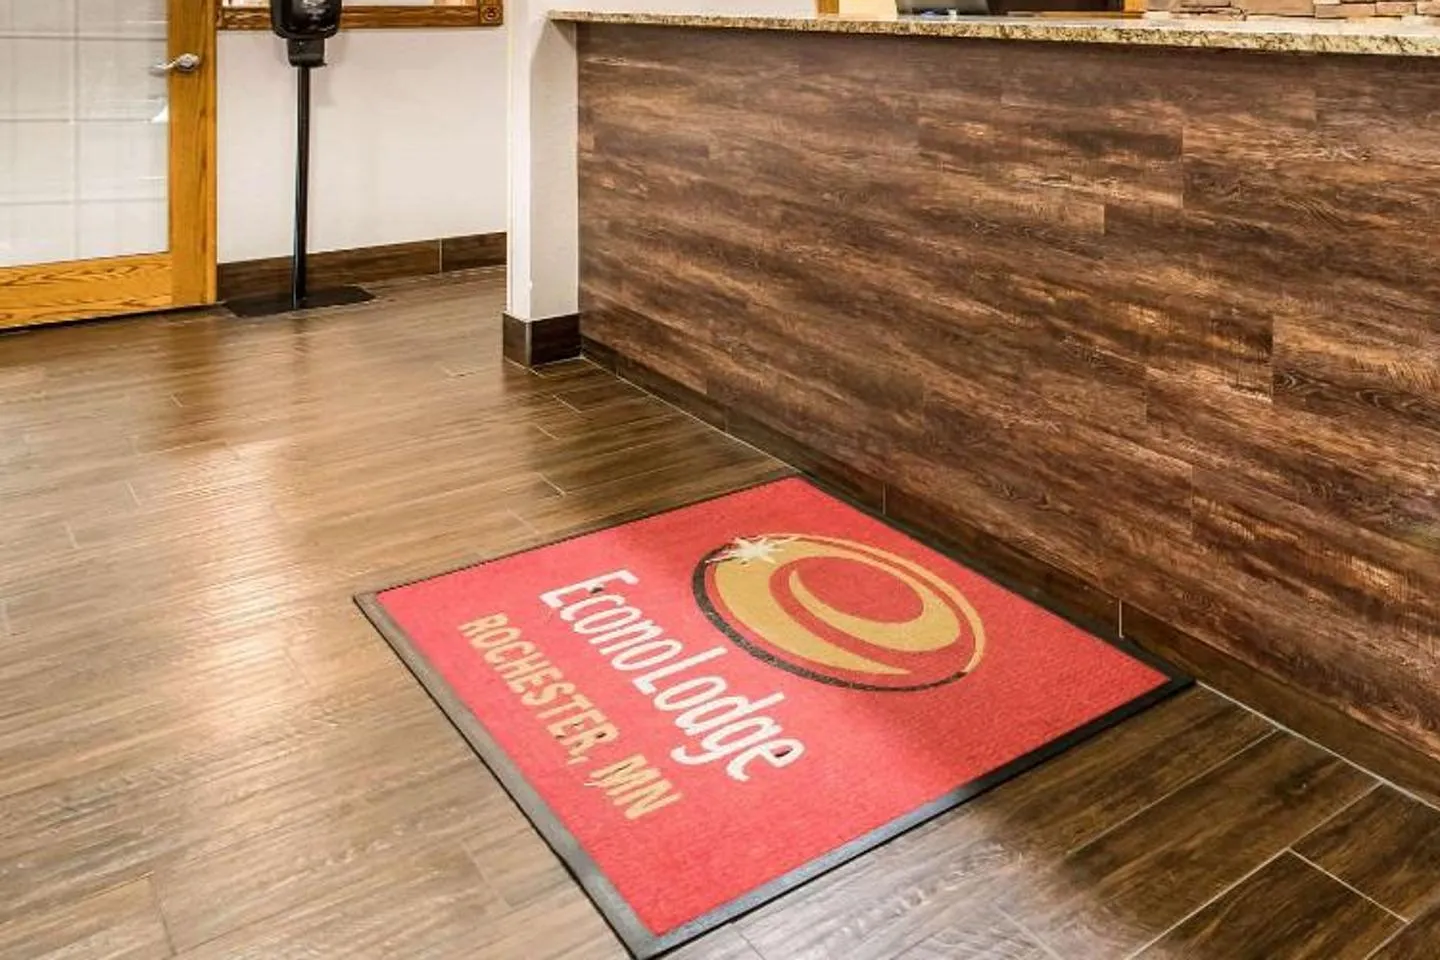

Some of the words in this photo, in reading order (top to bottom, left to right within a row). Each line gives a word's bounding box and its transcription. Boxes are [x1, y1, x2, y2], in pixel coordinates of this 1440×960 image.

[458, 612, 620, 765] ROCHESTER,
[584, 753, 683, 821] MN
[539, 568, 805, 782] EconoLodge
